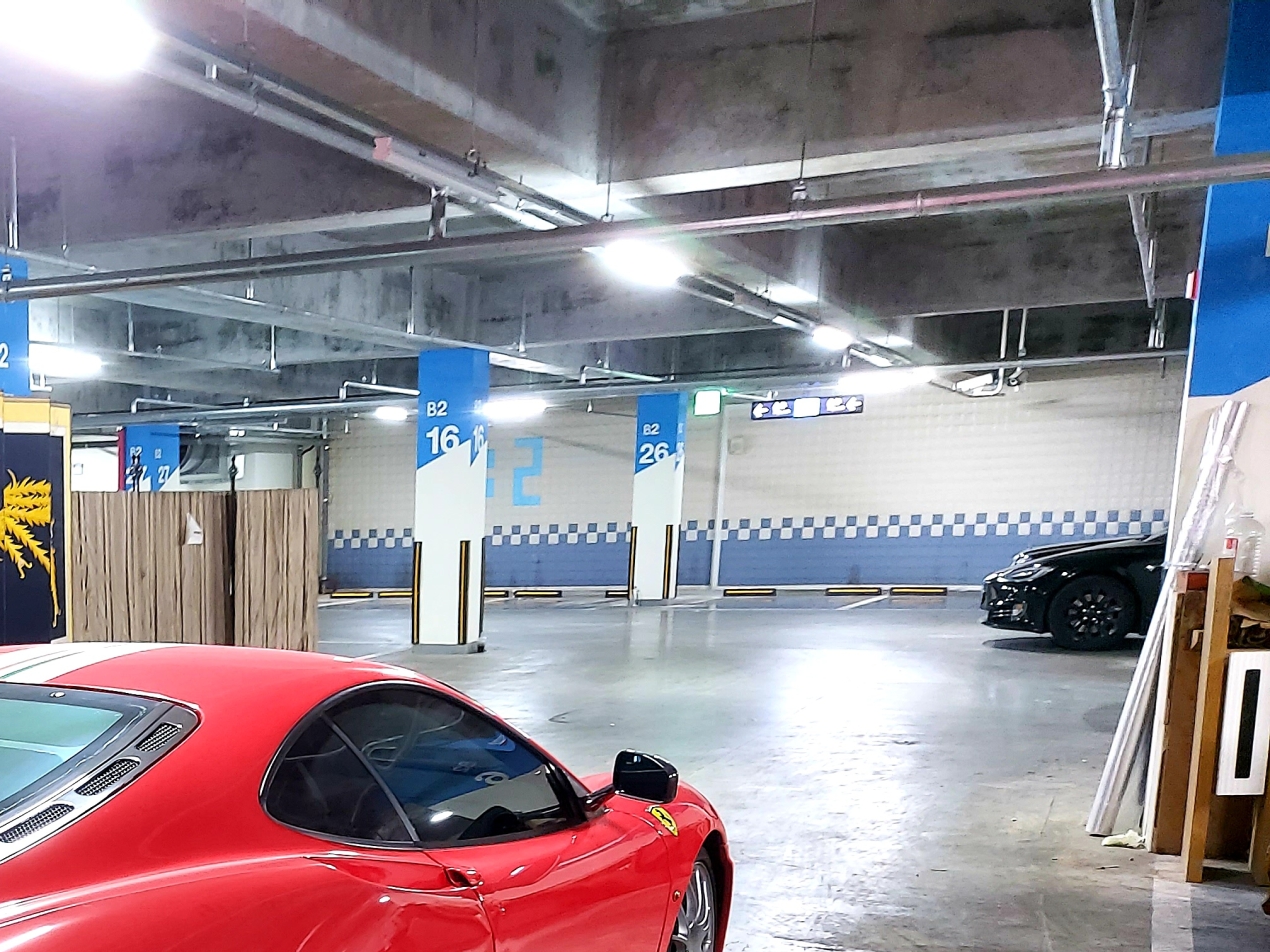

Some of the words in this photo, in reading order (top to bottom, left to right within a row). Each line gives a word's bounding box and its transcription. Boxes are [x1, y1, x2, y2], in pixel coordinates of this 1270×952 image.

[426, 401, 448, 417] B2
[473, 424, 485, 453] 16
[642, 423, 660, 435] B2
[426, 425, 460, 455] 16
[638, 442, 670, 464] 26
[158, 465, 170, 483] 27
